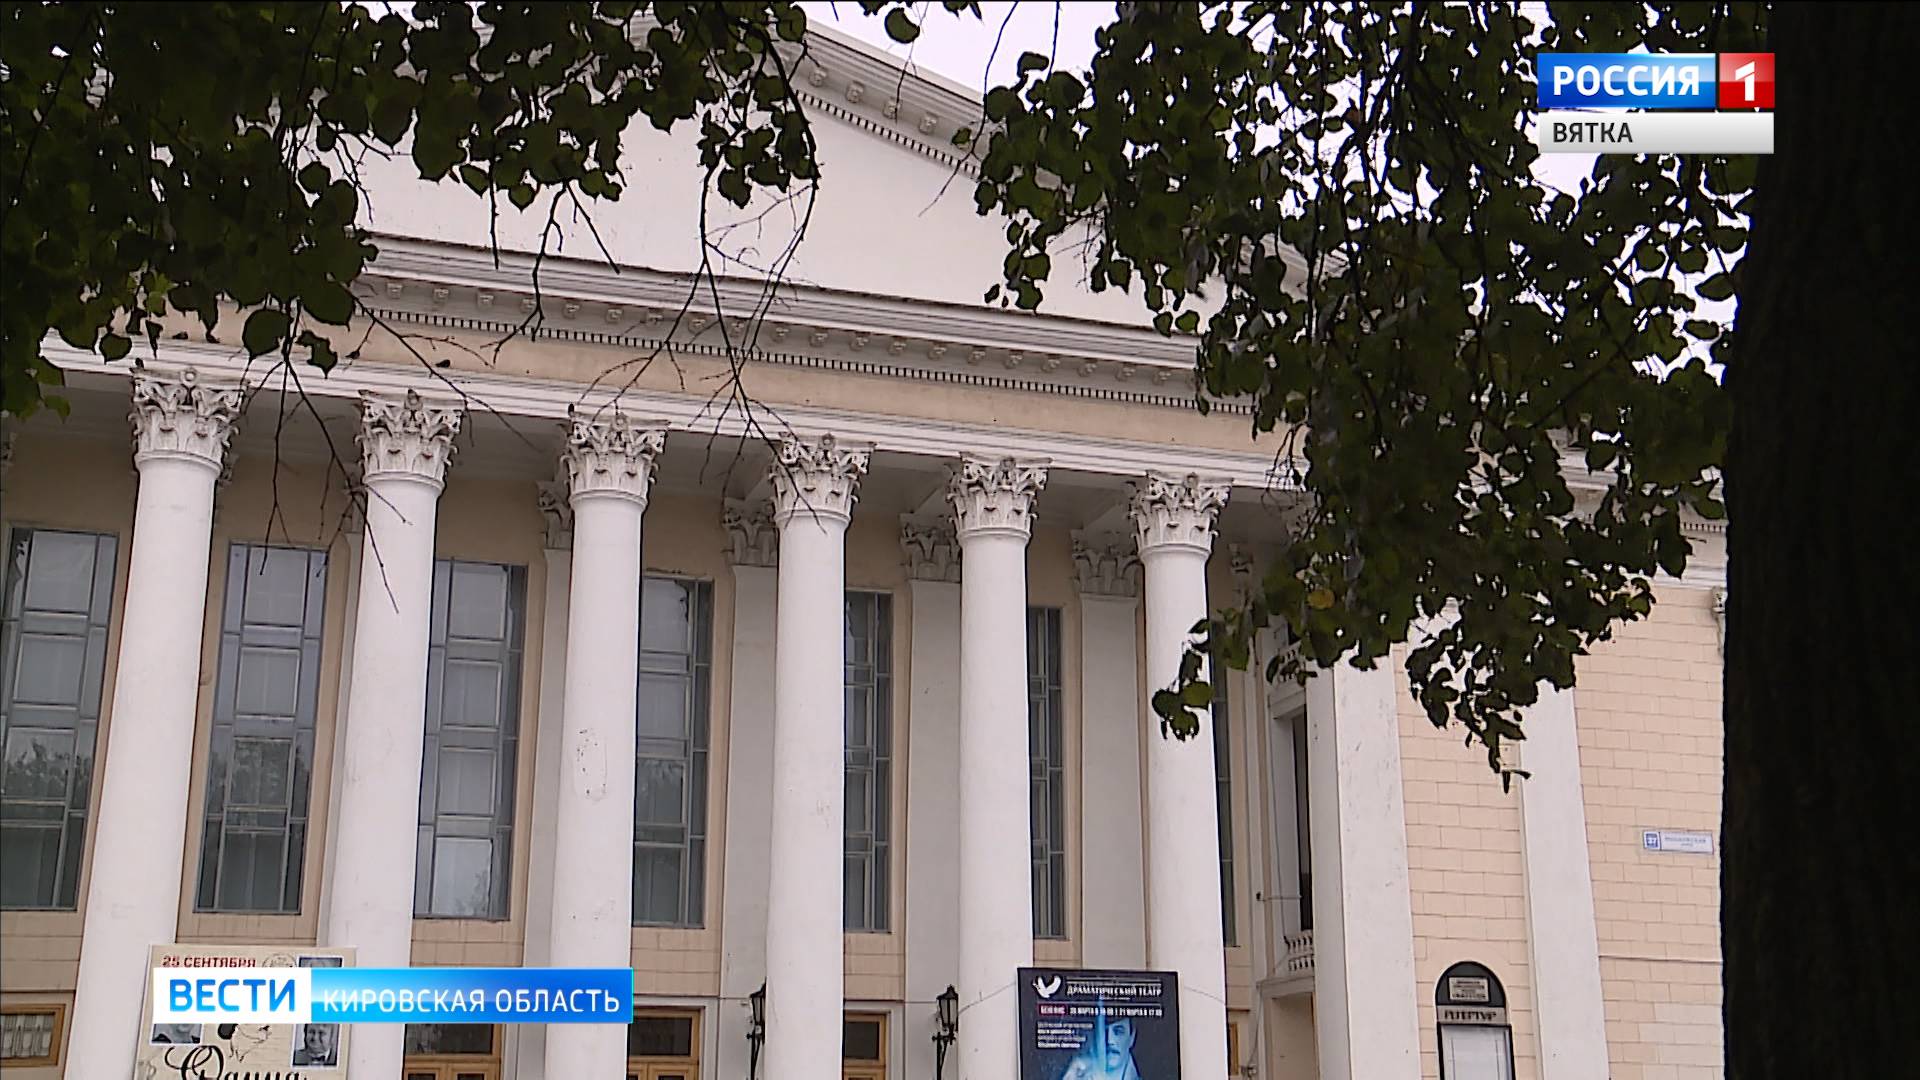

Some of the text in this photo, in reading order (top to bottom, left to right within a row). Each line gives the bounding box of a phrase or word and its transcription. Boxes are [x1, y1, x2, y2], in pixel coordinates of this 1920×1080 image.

[161, 955, 256, 968] 25 СЕНТЯБРЯ
[1066, 984, 1162, 997] ДРАМАТИЧЕСКИЙ ТЕАТР
